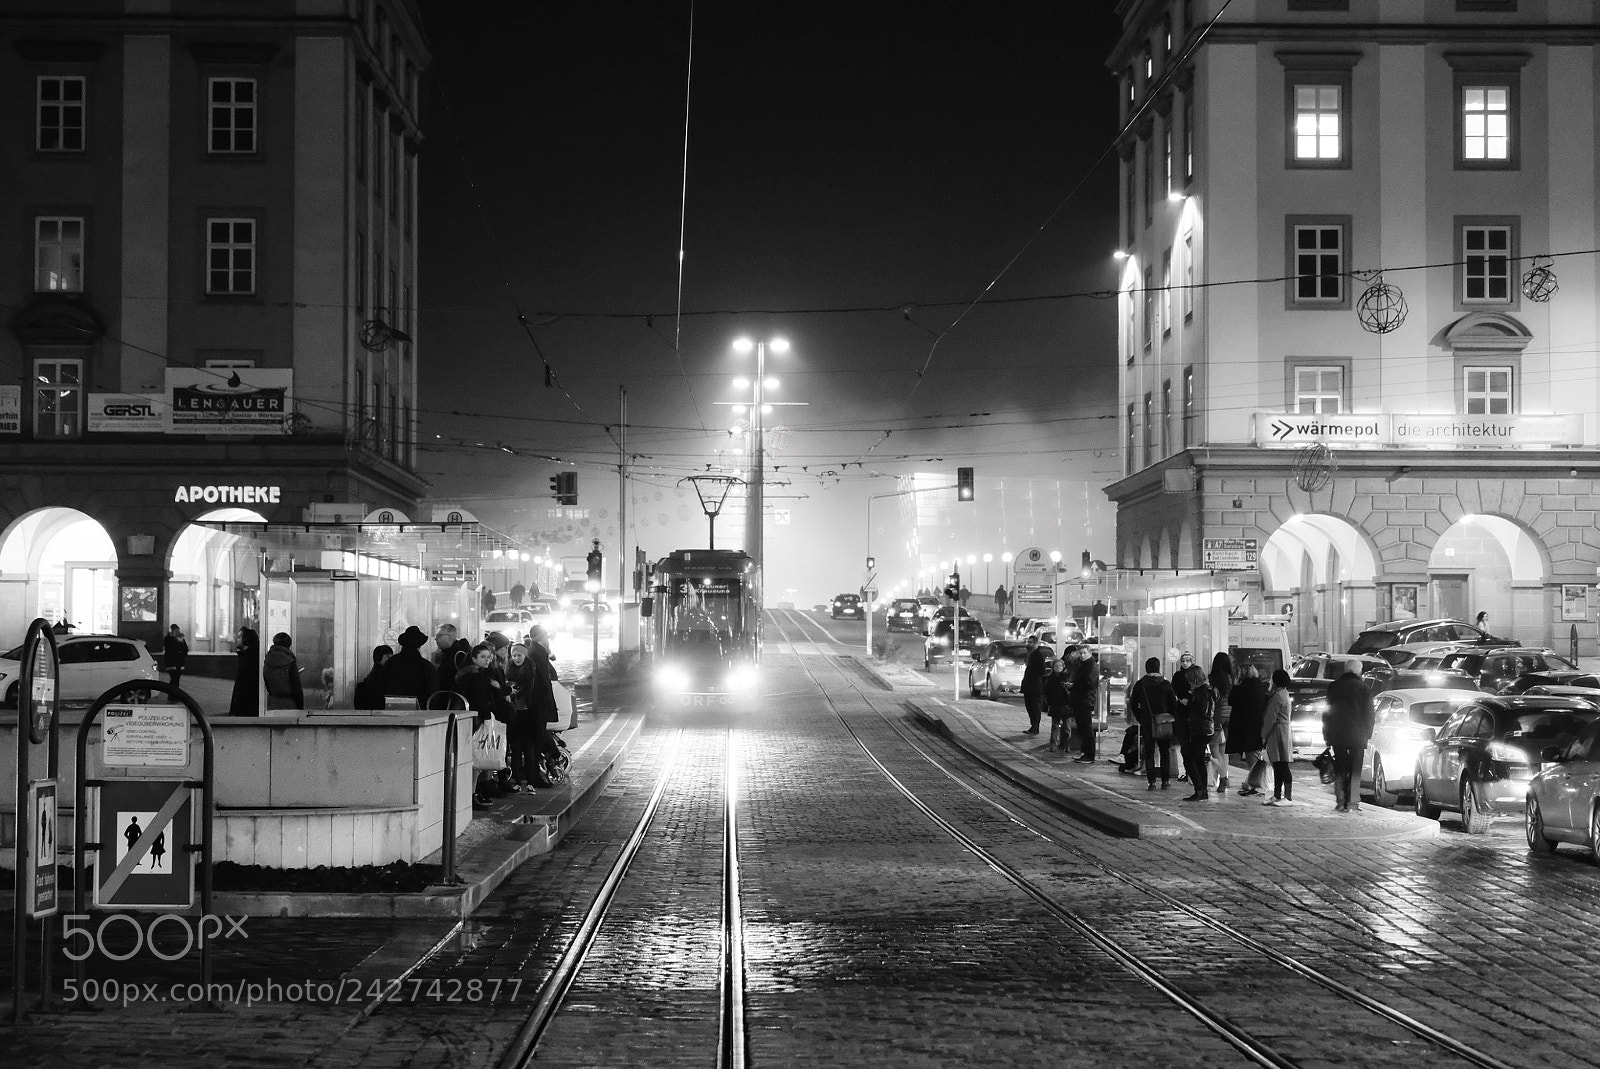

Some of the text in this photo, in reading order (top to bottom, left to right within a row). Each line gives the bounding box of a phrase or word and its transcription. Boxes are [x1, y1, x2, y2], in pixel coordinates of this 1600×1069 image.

[104, 404, 155, 416] GERSTL
[1297, 421, 1379, 439] wärmepol
[1398, 423, 1421, 436] die
[1427, 422, 1515, 436] architektur
[174, 485, 281, 503] APOTHEKE
